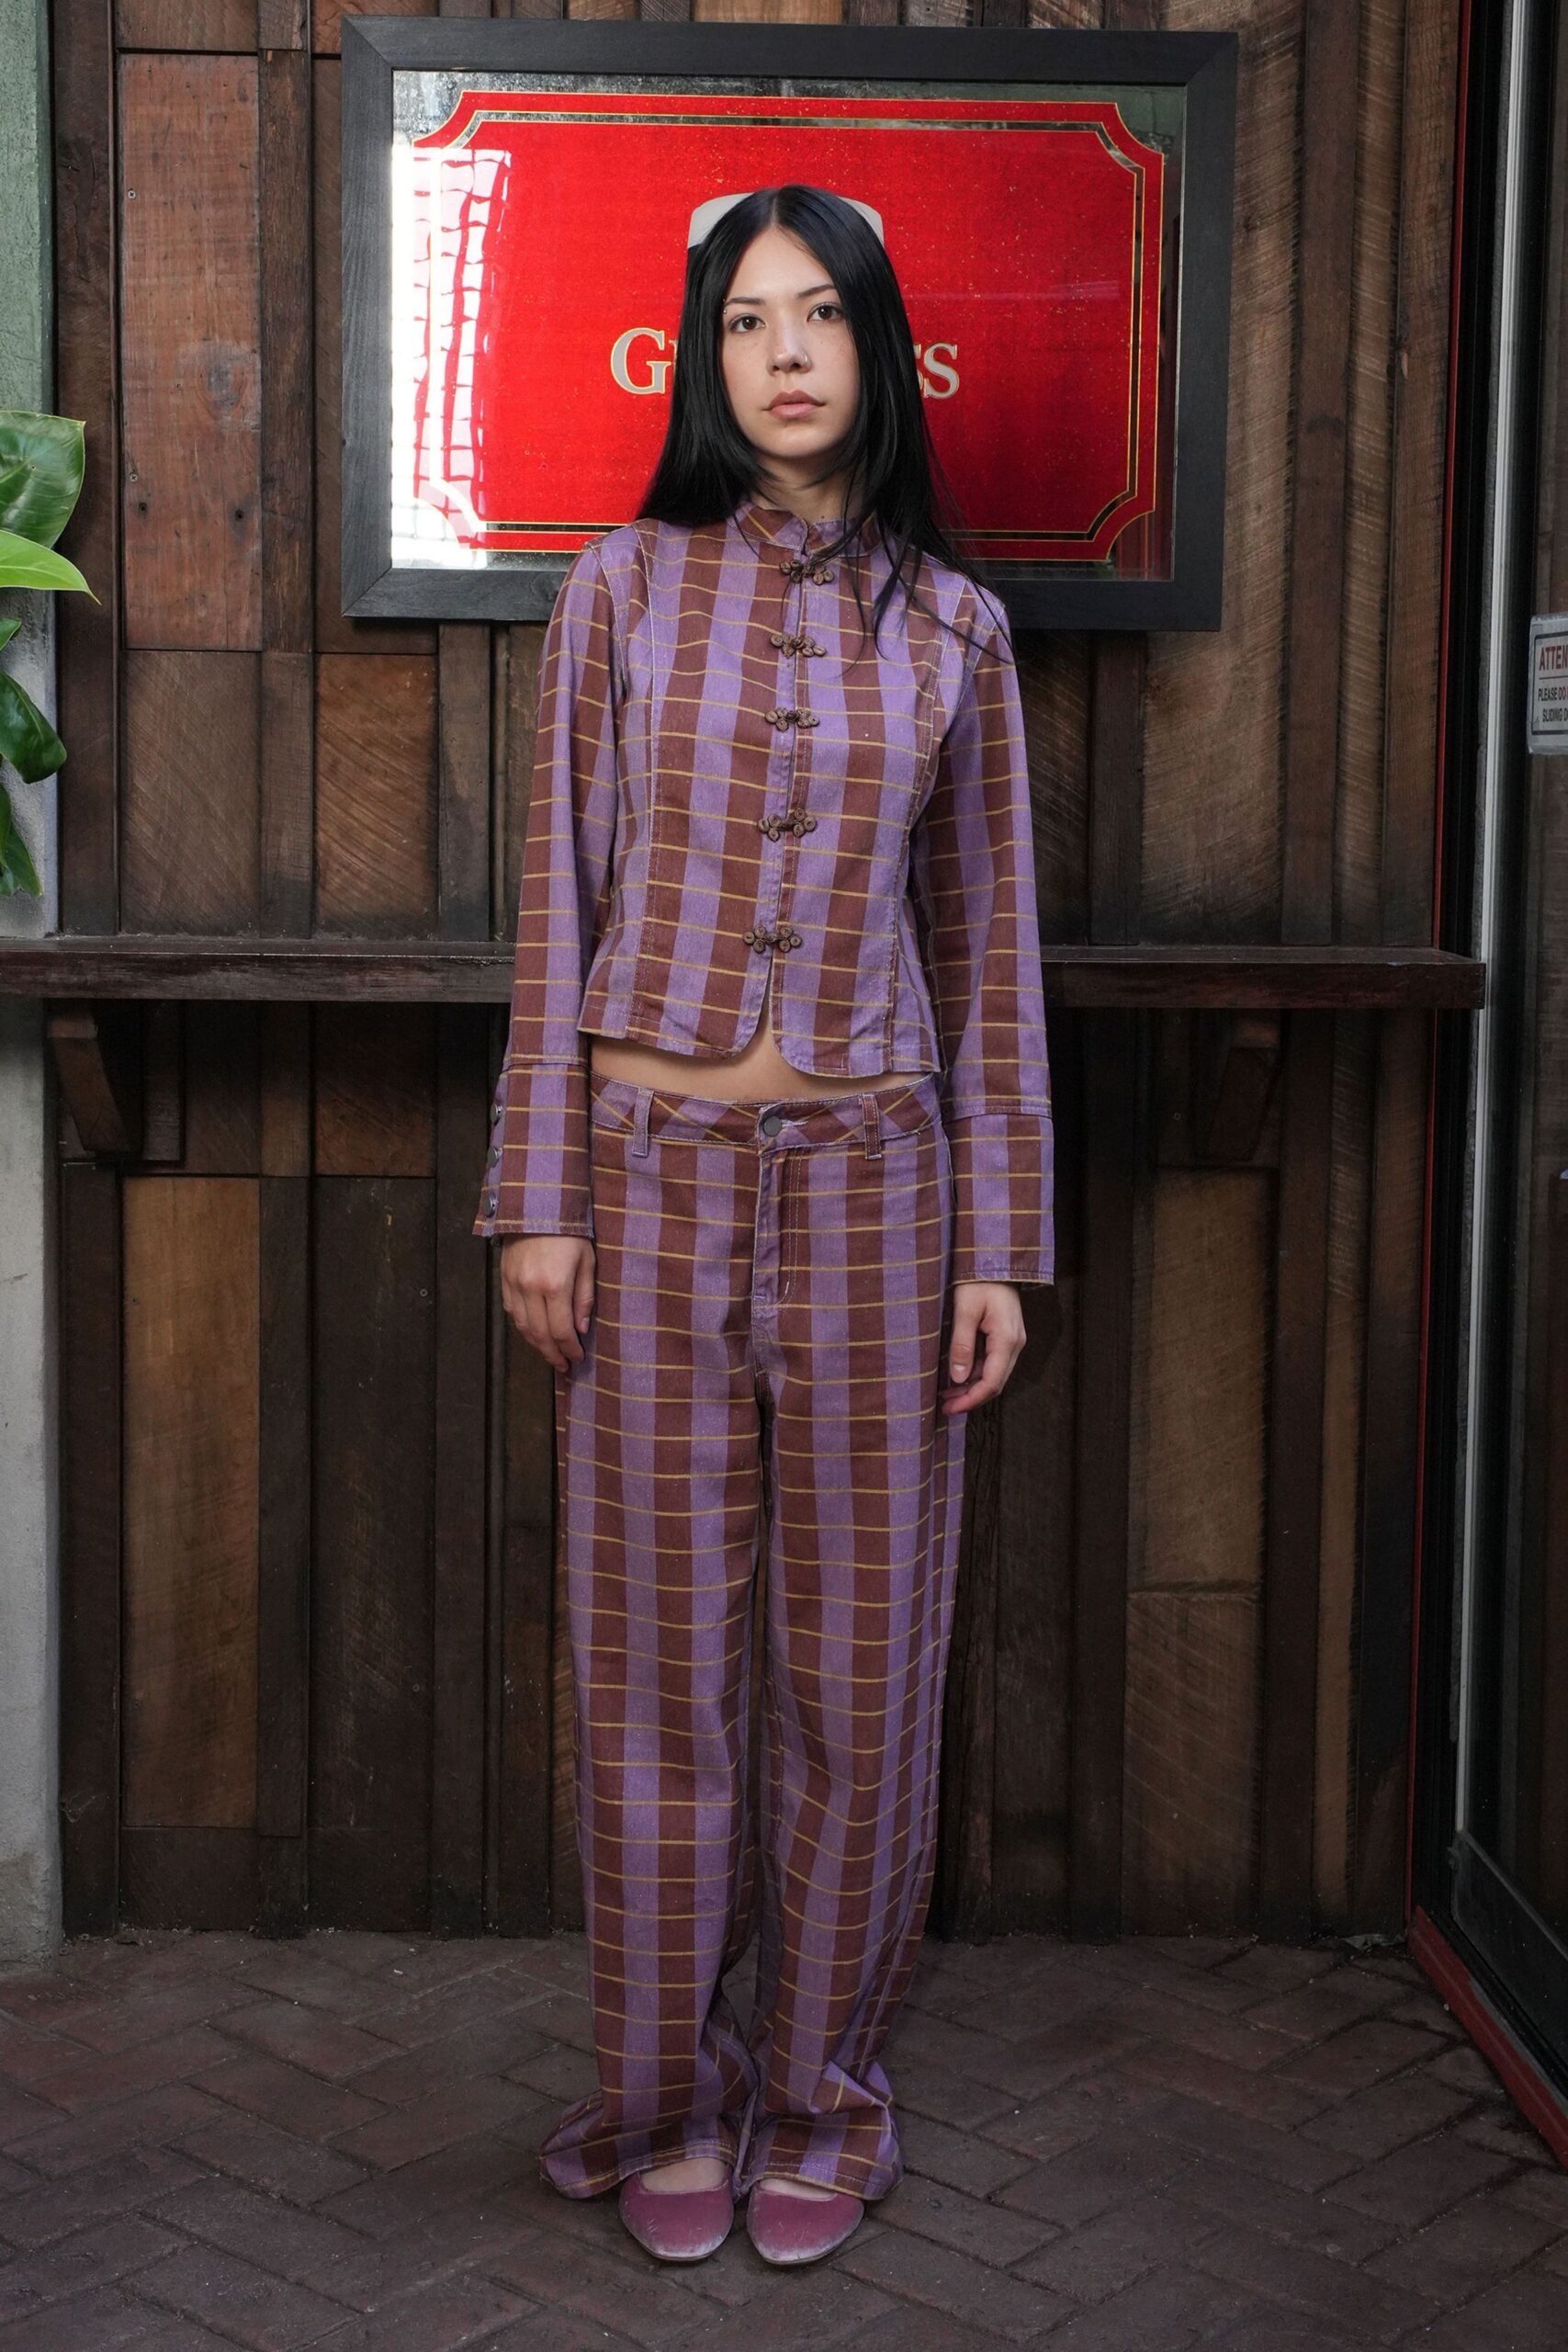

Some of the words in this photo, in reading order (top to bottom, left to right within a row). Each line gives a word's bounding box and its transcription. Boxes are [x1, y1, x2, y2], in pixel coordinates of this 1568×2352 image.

[1538, 686, 1557, 701] PLEASE
[1558, 685, 1566, 700] DO
[1542, 708, 1562, 721] SLIDING
